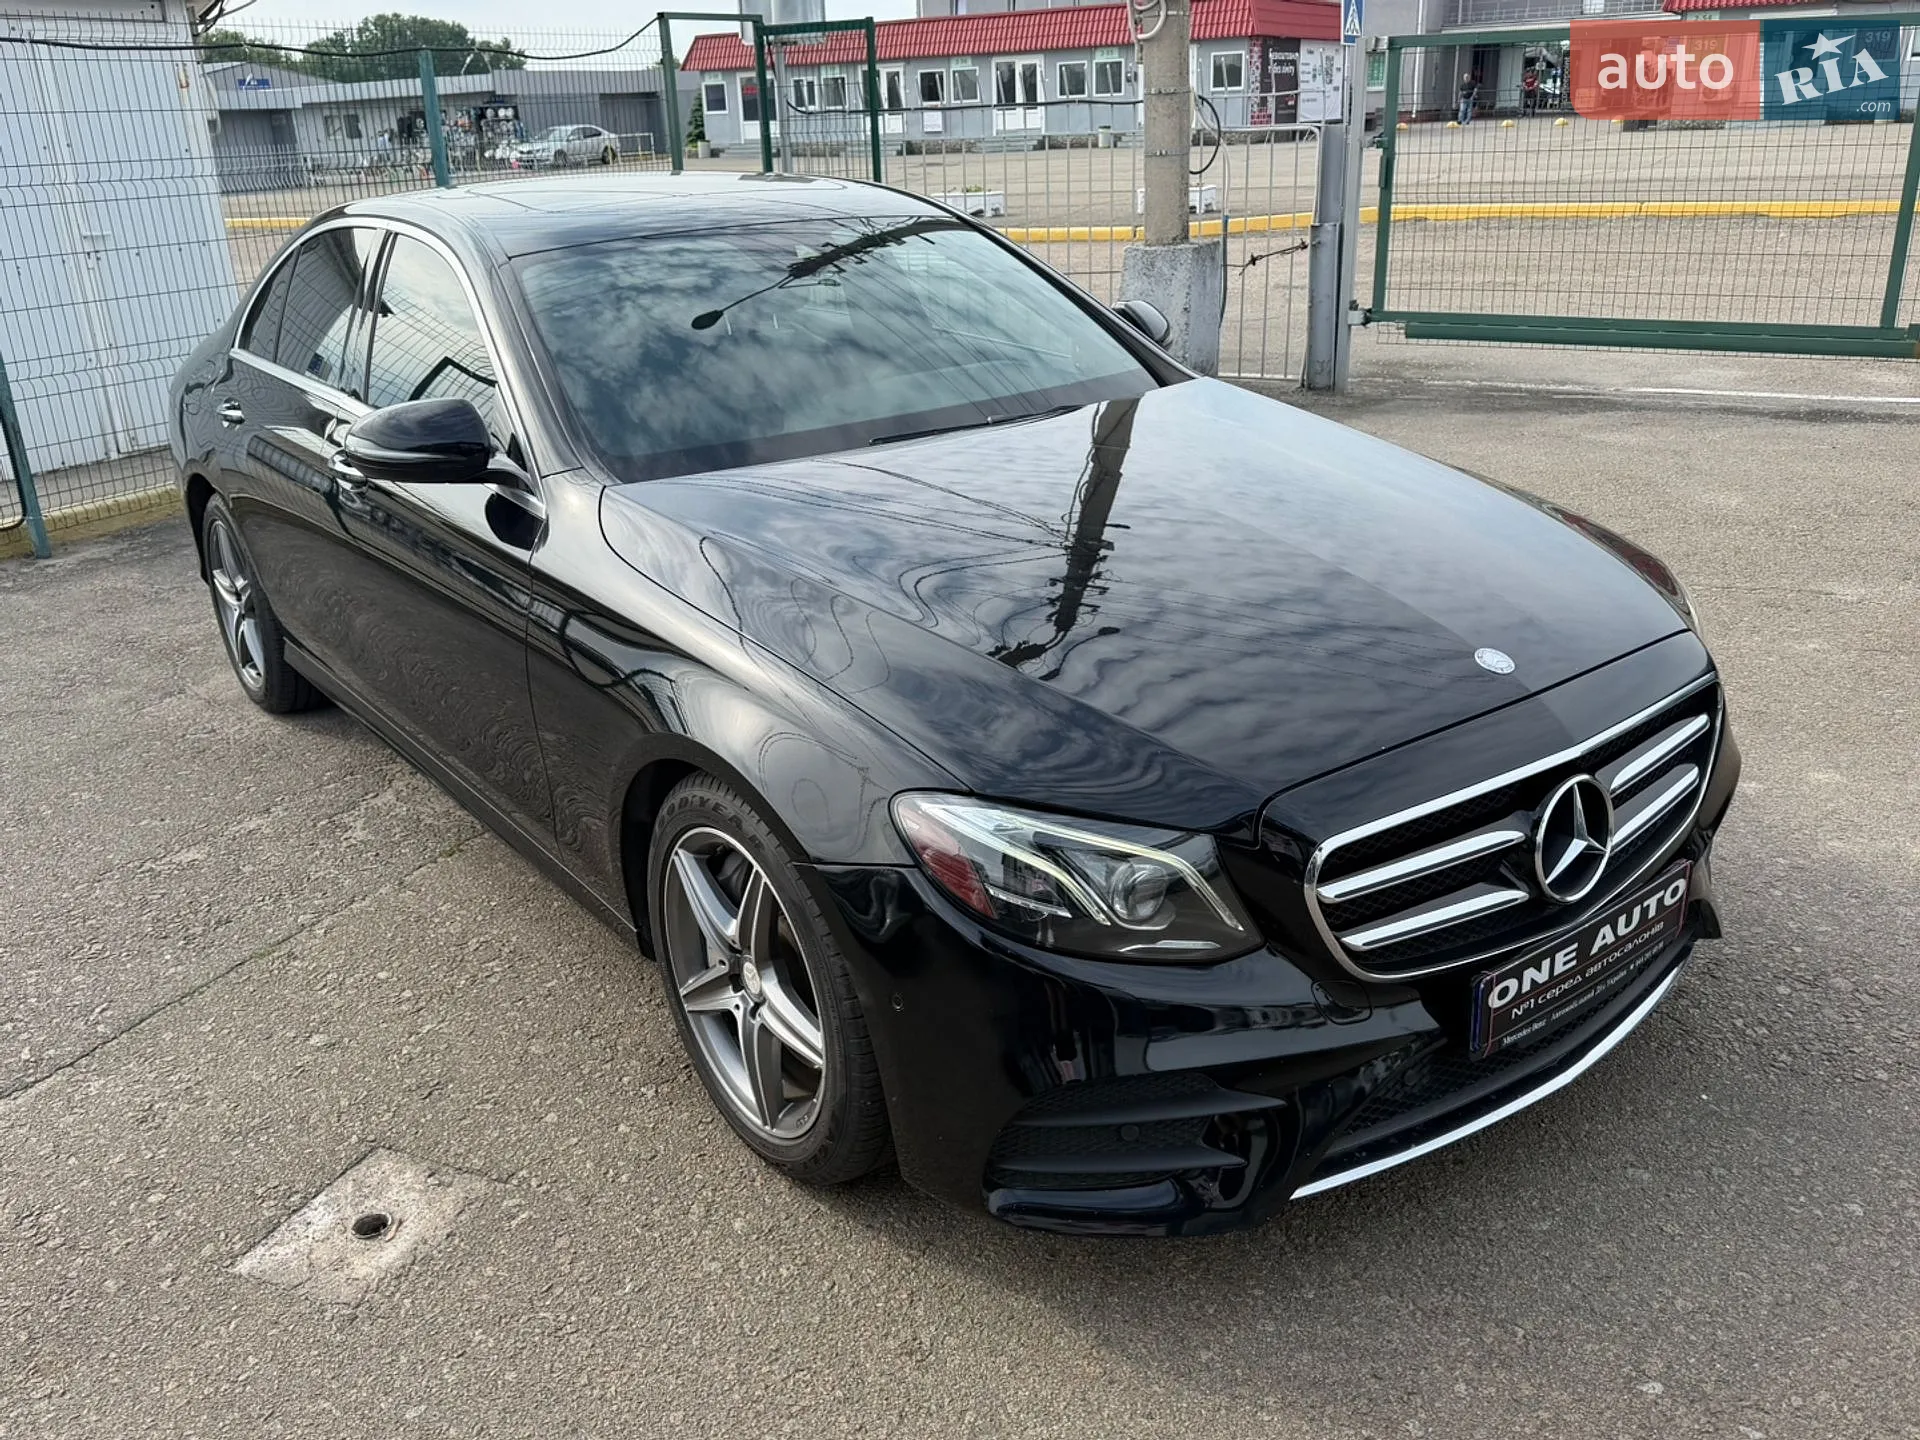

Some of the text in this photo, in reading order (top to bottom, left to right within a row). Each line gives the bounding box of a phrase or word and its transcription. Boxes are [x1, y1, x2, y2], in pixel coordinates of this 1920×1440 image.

[653, 794, 765, 850] OODYEAR
[1488, 942, 1579, 1008] ONE
[1589, 878, 1687, 957] AUTO
